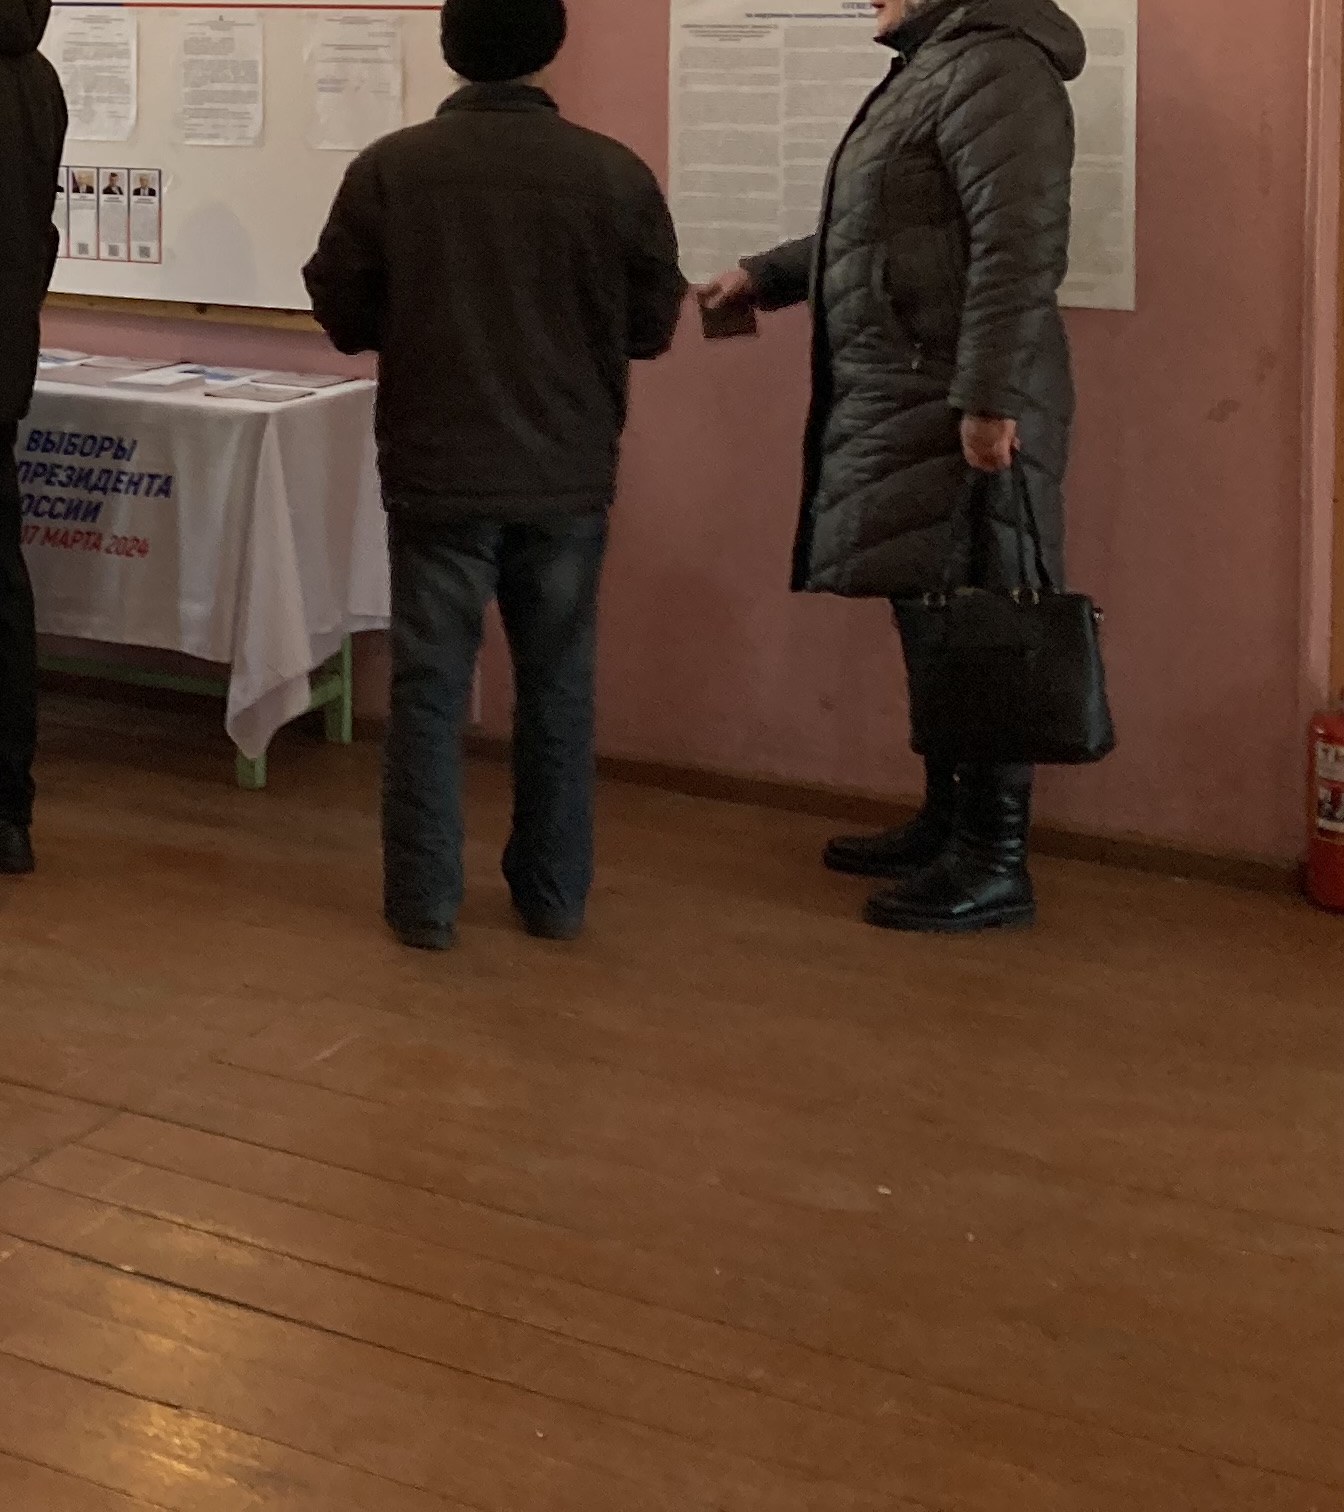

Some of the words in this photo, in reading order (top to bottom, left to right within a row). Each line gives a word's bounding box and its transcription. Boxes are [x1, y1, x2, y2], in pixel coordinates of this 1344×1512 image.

[25, 429, 138, 462] ВЫБОРЫ
[18, 460, 173, 499] ПРЕЗИДЕНТА
[21, 493, 104, 524] ОССИИ
[41, 527, 104, 553] МАРТА
[105, 535, 150, 558] 2024
